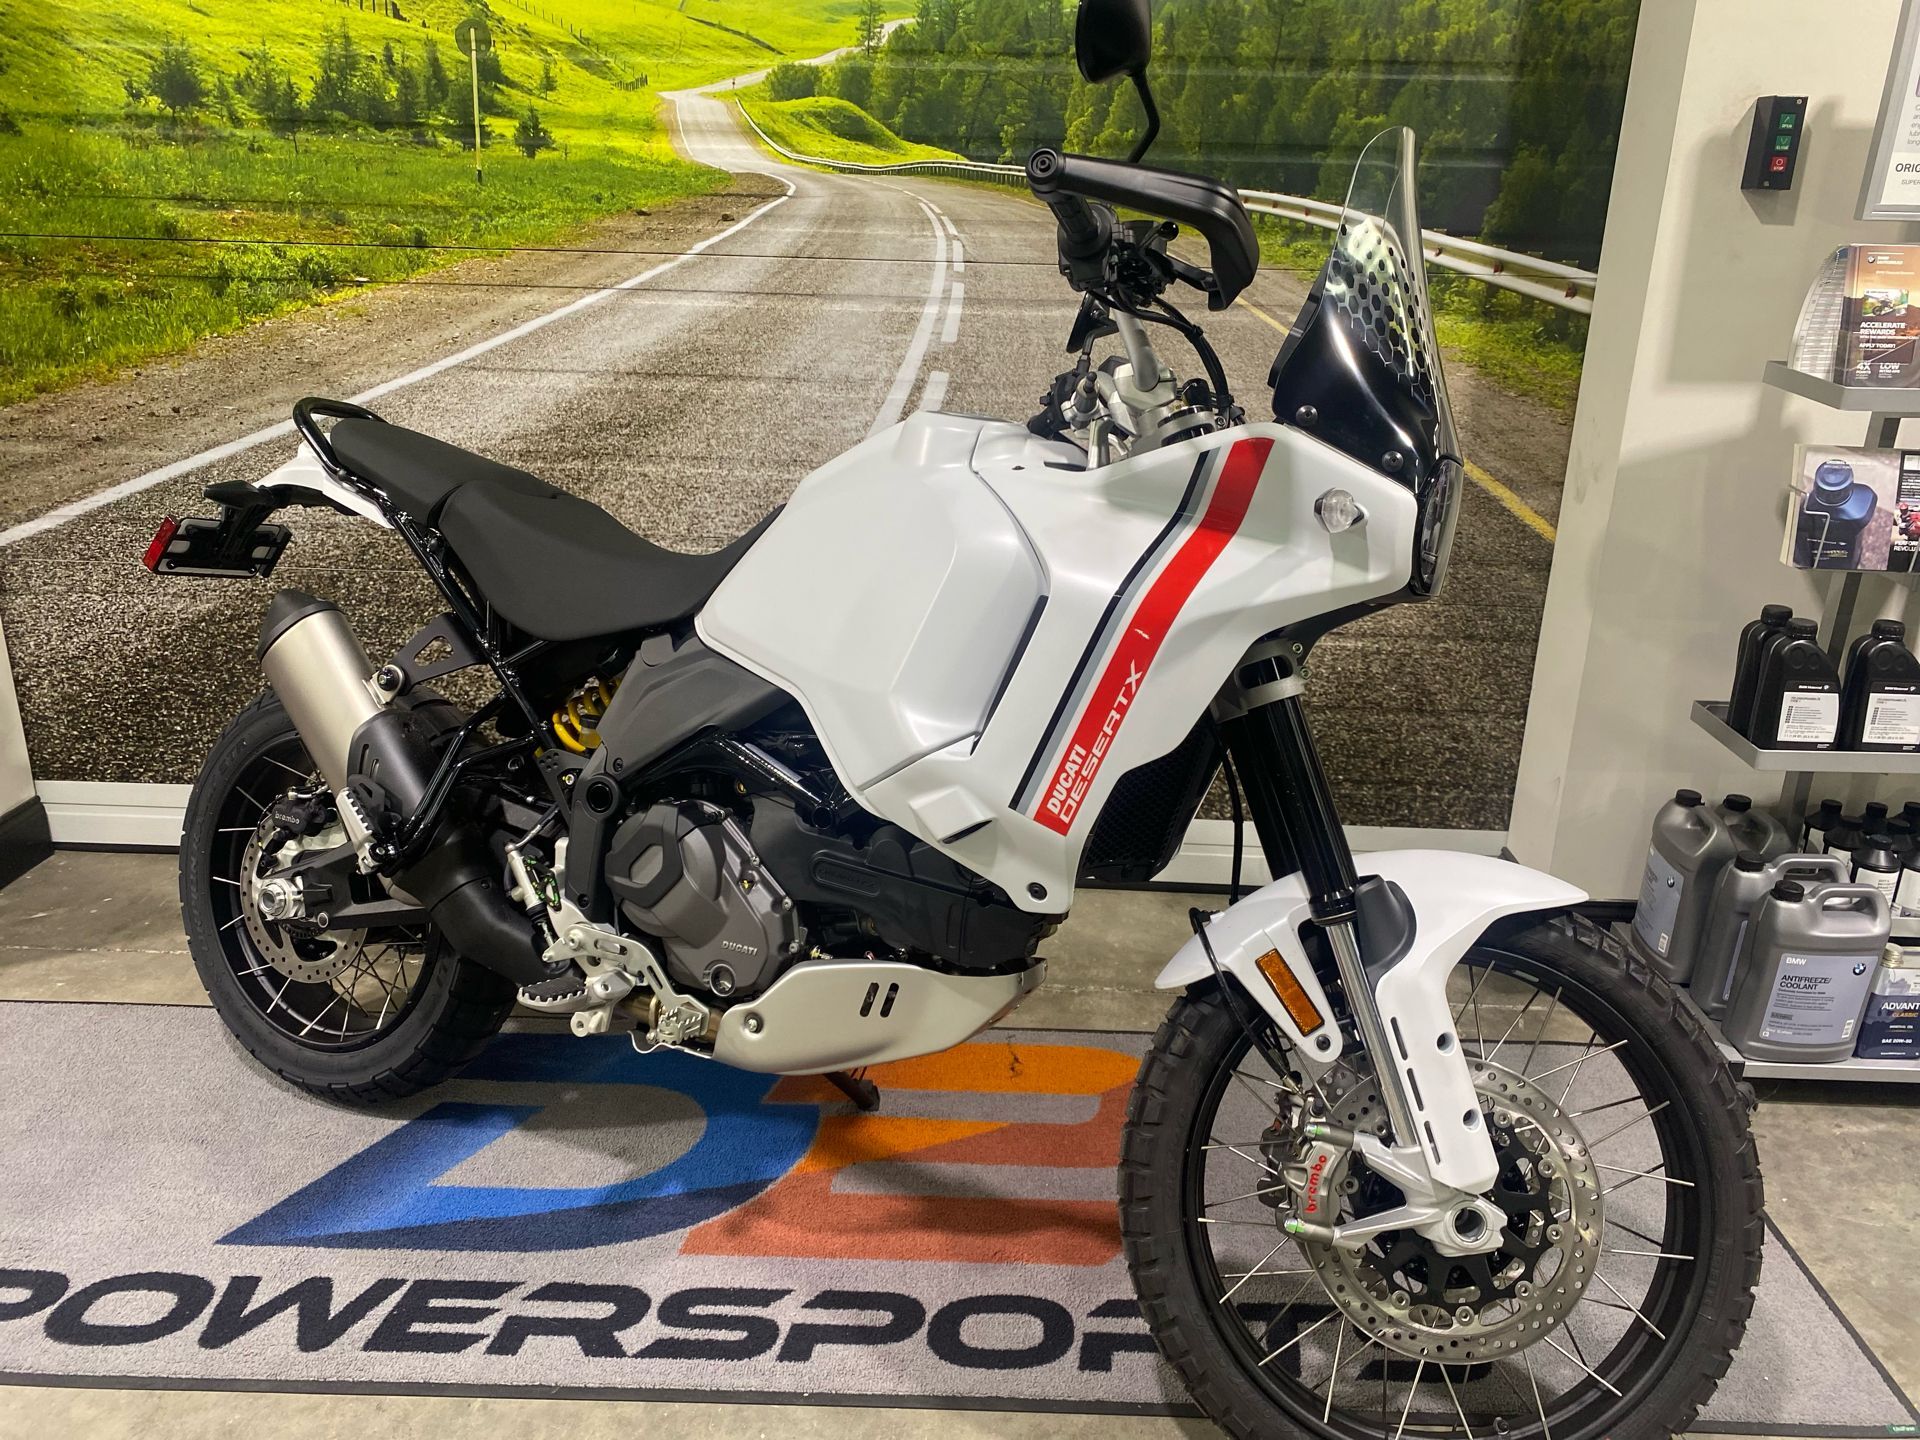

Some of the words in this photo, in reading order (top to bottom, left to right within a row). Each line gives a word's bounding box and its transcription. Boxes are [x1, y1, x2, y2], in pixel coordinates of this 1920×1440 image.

[1860, 321, 1906, 329] ACCELERATE
[1860, 328, 1896, 336] REWARDS
[1879, 362, 1900, 370] LOW
[1047, 744, 1086, 815] DUCATI
[275, 811, 300, 824] brembo
[720, 940, 758, 956] DUCATI
[1785, 957, 1807, 965] BMW
[1781, 974, 1832, 985] ANTIFREEZE/
[1779, 981, 1818, 990] COOLANT
[1881, 1002, 1920, 1010] ADVANT
[1304, 1155, 1327, 1213] brembo
